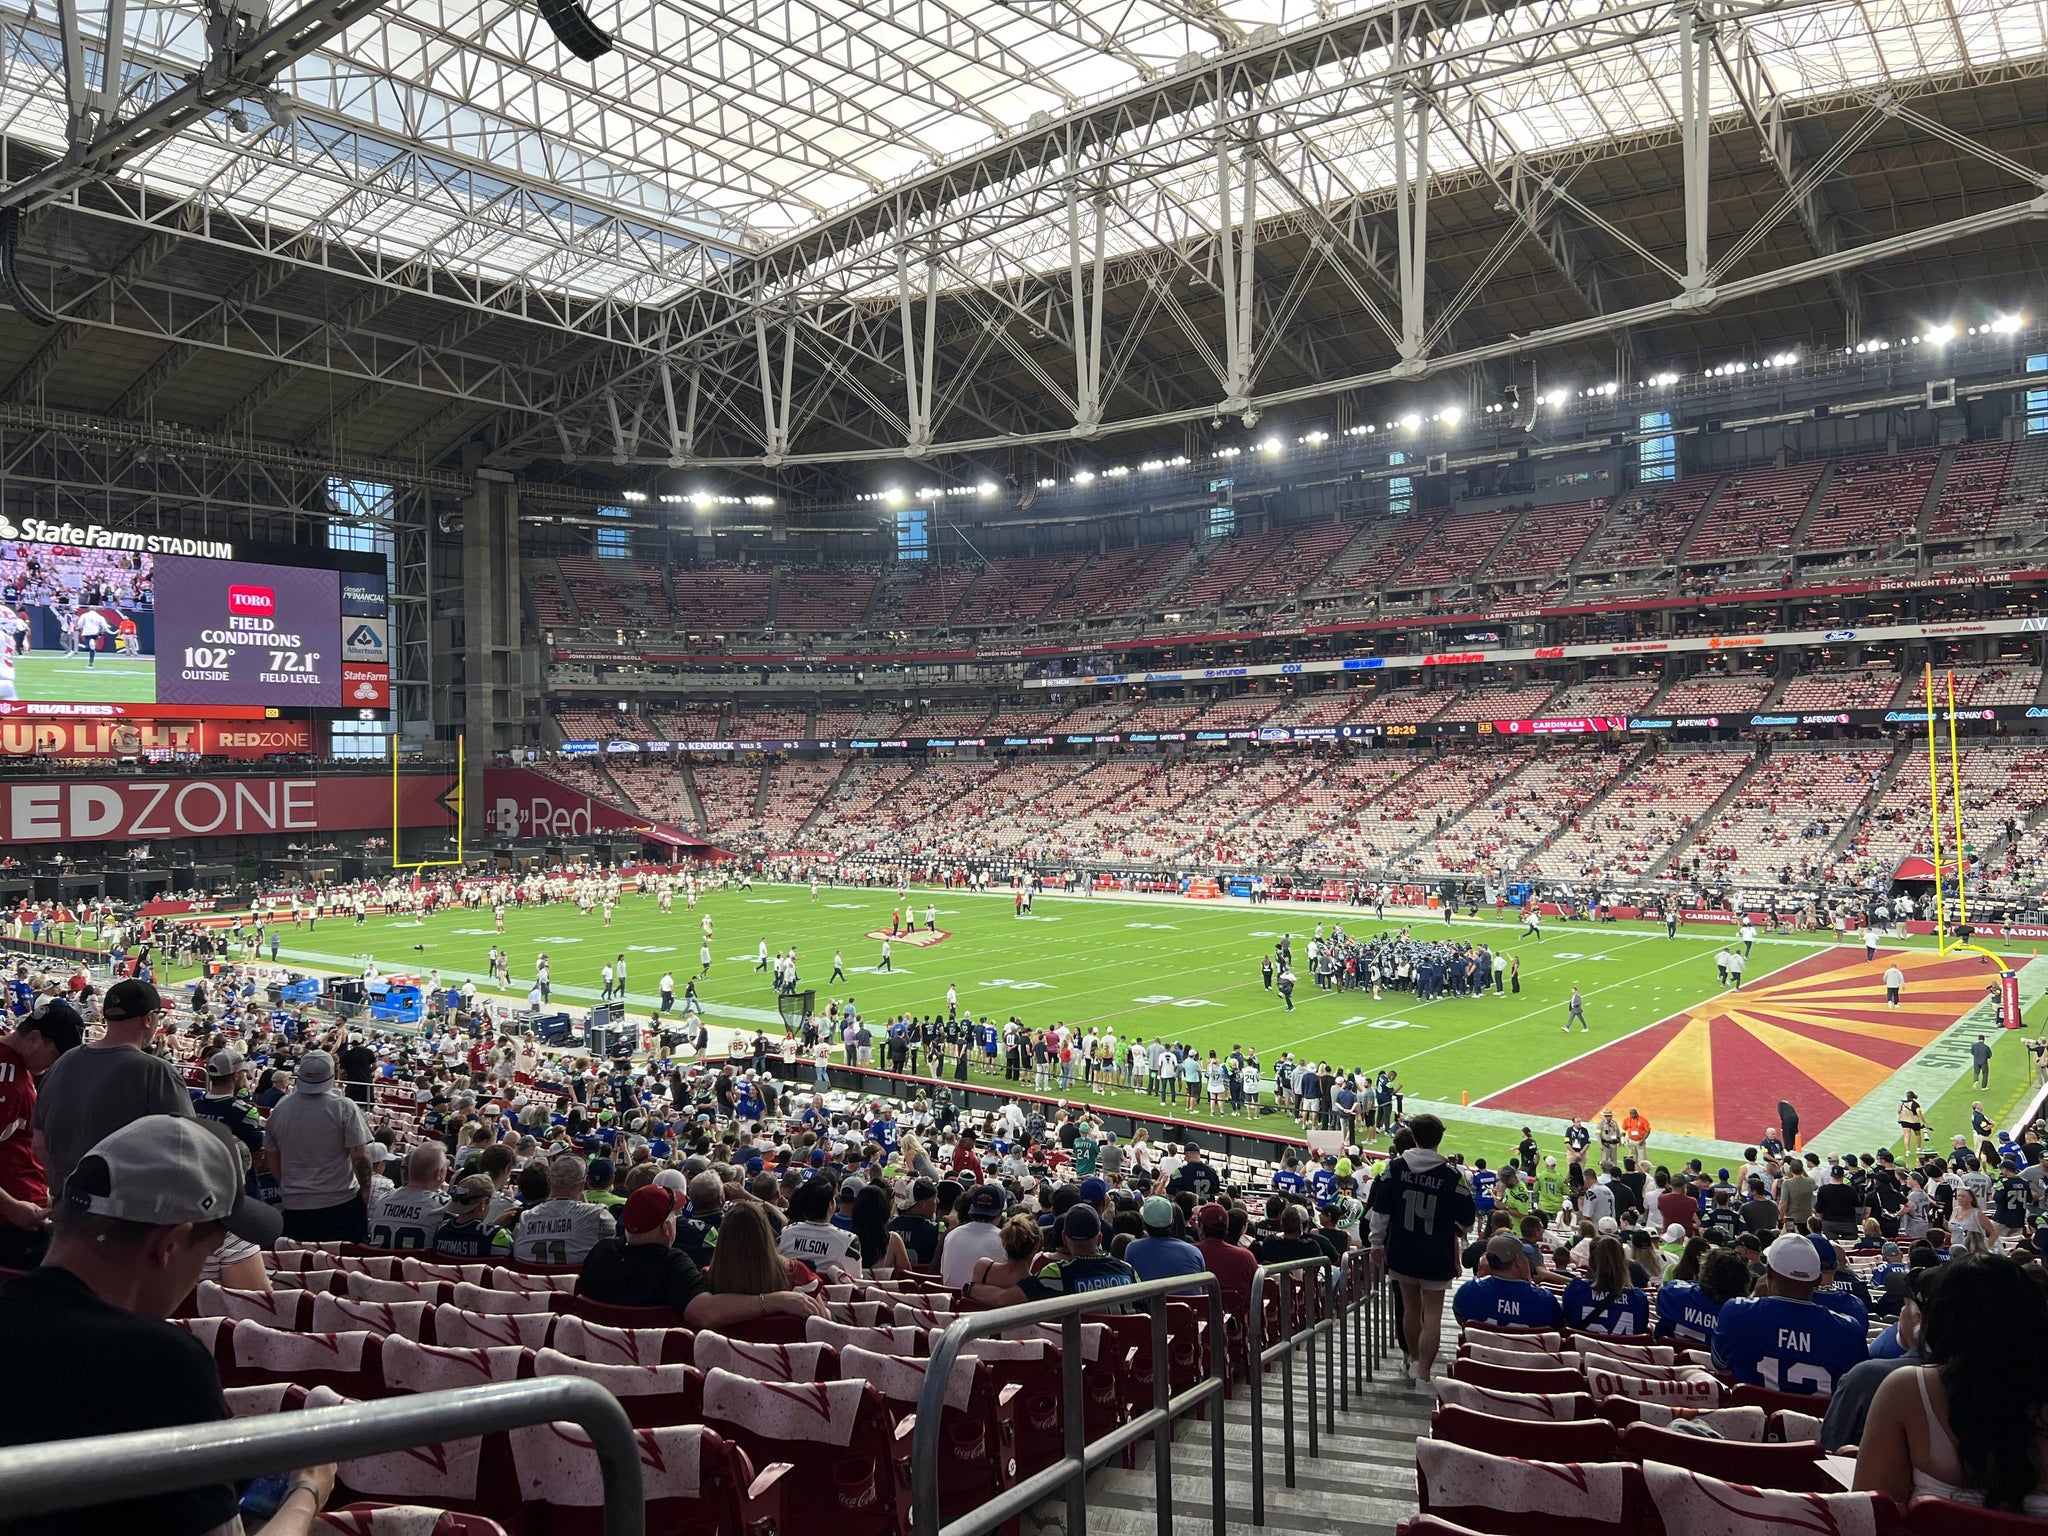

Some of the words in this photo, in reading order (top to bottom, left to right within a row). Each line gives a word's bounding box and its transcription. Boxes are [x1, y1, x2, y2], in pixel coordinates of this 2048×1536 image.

[147, 535, 232, 560] STADIUM
[1881, 582, 1902, 590] DICK
[1906, 578, 1940, 588] (NIGHT
[1944, 576, 1980, 585] TRAIN)
[1983, 574, 2011, 582] LANE
[1485, 612, 1509, 620] LARRY
[1511, 610, 1541, 618] WILSON
[229, 617, 274, 632] FIELD
[201, 630, 301, 647] CONDITIONS
[347, 646, 382, 655] Albertsons
[182, 670, 230, 681] OUTSIDE
[1216, 668, 1247, 676] HYUNDAI
[1282, 664, 1302, 673] COX
[260, 673, 288, 683] FIELD
[290, 673, 321, 684] LEVEL
[27, 704, 114, 715] RIVALRIES
[360, 709, 373, 719] 25
[1480, 723, 1491, 731] 25
[1510, 722, 1519, 732] 0
[1532, 720, 1585, 729] CARDINALS
[1677, 719, 1708, 727] SAFEWAY
[1802, 715, 1838, 724] SAFEWAY
[1343, 727, 1351, 736] 0
[1386, 725, 1417, 735] 29:26
[0, 724, 67, 753] UD
[74, 725, 195, 753] LIGHT
[219, 732, 309, 747] REDZONE
[688, 742, 734, 750] KENDRICK
[0, 781, 318, 840] EDZONE
[1401, 1170, 1444, 1191] METCALF
[1193, 1179, 1211, 1199] 12
[2007, 1190, 2028, 1210] 24
[383, 1203, 422, 1219] THOMAS
[1402, 1189, 1438, 1236] 14
[526, 1218, 572, 1235] SMITH-NJIGBA
[436, 1239, 468, 1255] THOMAS
[469, 1240, 478, 1255] III
[531, 1239, 567, 1264] 11
[794, 1237, 829, 1256] WILSON
[1497, 1299, 1520, 1316] FAN
[1684, 1307, 1719, 1330] WAGN
[1778, 1328, 1811, 1353] FAN
[1757, 1356, 1833, 1397] 12
